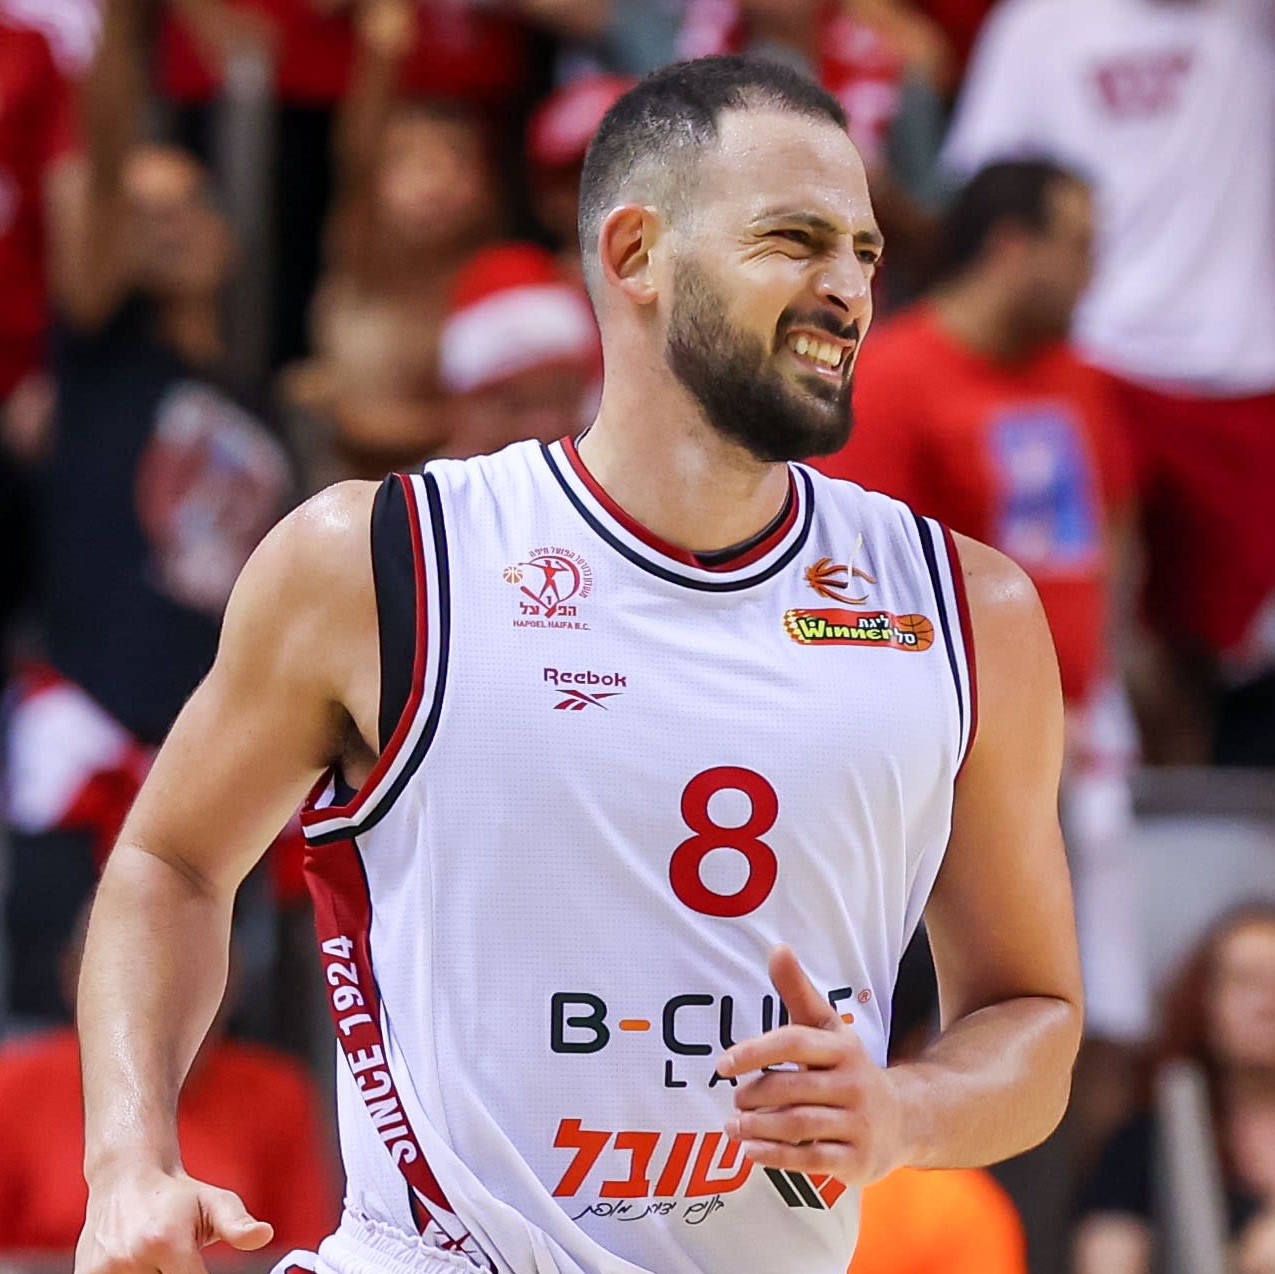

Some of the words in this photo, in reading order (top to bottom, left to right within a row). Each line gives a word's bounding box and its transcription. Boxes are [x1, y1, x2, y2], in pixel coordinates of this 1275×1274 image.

[513, 620, 547, 628] HAPOEL
[548, 620, 573, 630] HAIFA
[797, 618, 894, 641] Winner
[895, 628, 916, 645] סל
[543, 668, 627, 687] Reebok
[669, 766, 779, 918] 8
[322, 935, 374, 1037] 1924
[348, 1044, 418, 1167] SINCE
[551, 1119, 755, 1198] שובל
